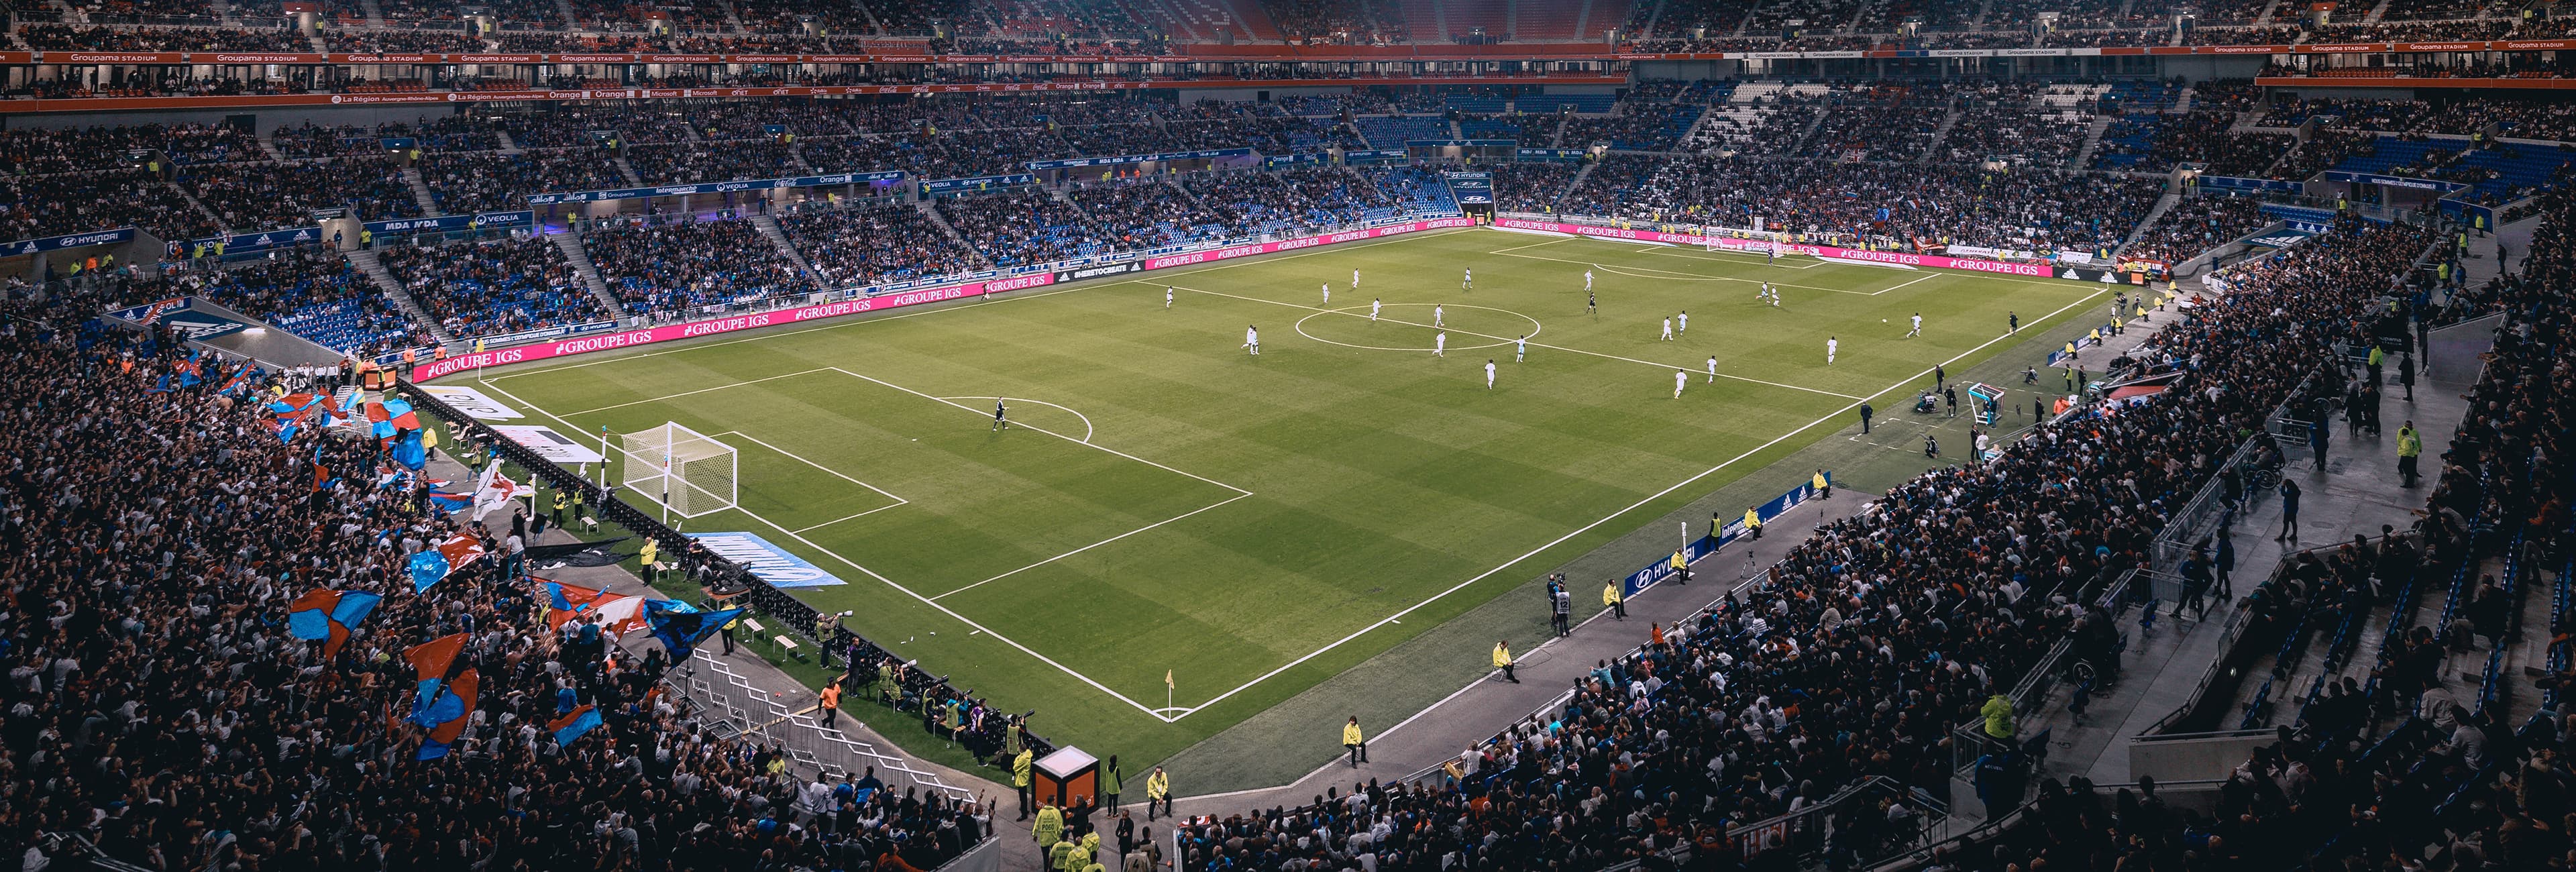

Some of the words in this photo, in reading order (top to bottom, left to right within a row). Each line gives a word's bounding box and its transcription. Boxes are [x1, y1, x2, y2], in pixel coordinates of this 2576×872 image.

[354, 95, 380, 103] Région
[549, 91, 580, 99] Orange
[596, 91, 625, 99] Orange
[820, 176, 845, 184] Orange
[657, 186, 698, 194] Intermarché
[386, 223, 410, 231] MDA
[1383, 226, 1405, 235] GROUPE
[1407, 224, 1415, 232] IGS
[1510, 221, 1544, 229] GROUPE
[1546, 223, 1559, 231] IGS
[78, 233, 119, 244] HYUNDAI
[1335, 233, 1358, 242] GROUPE
[1360, 231, 1370, 239] IGS
[1582, 227, 1619, 237] GROUPE
[1621, 230, 1636, 239] IGS
[1282, 240, 1307, 250] GROUPE
[1309, 237, 1319, 246] IGS
[1222, 249, 1250, 258] GROUPE
[1252, 246, 1263, 254] IGS
[1848, 250, 1896, 262] GROUPE
[1900, 255, 1920, 264] IGS
[1159, 256, 1189, 268] GROUPE
[1191, 254, 1203, 263] IGS
[1958, 260, 2012, 273] GROUPE
[2017, 265, 2038, 275] IGS
[989, 278, 1029, 292] GROUPE
[1030, 276, 1045, 286] IGS
[900, 289, 943, 303] GROUPE
[945, 288, 961, 298] IGS
[802, 301, 850, 319] GROUPE
[853, 300, 871, 312] IGS
[692, 317, 745, 335] GROUPE
[748, 314, 769, 327] IGS
[565, 335, 626, 353] GROUPE
[629, 331, 652, 343] IGS
[434, 353, 492, 375] GROUPE
[496, 349, 522, 364] IGS
[1654, 546, 1695, 579] HYUAI
